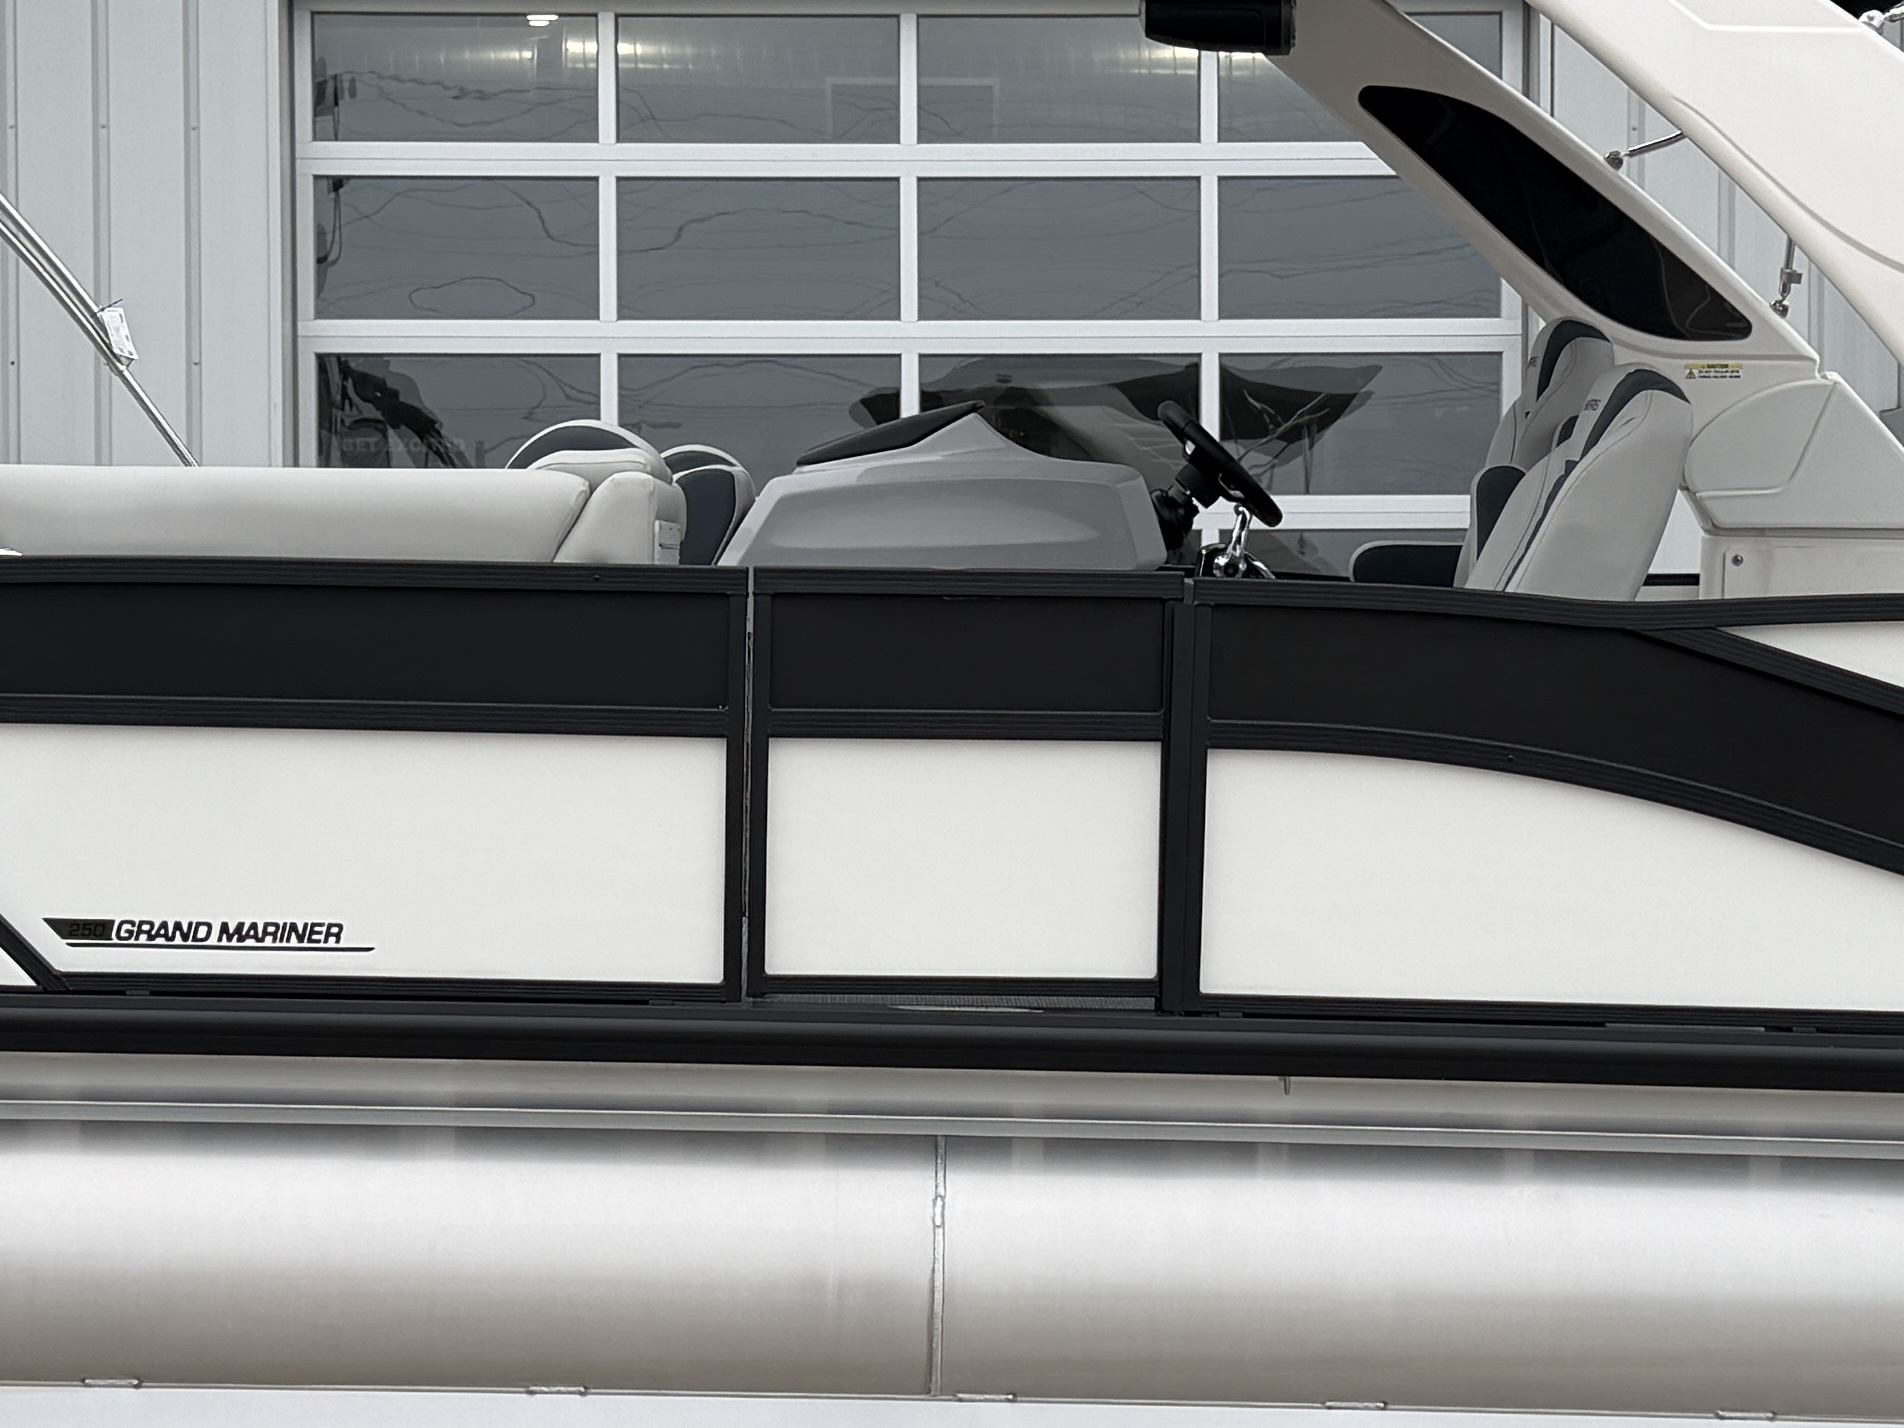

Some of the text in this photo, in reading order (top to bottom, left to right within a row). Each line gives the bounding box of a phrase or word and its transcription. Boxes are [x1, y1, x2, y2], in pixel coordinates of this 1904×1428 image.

[68, 919, 344, 944] 250 GRAND MARINER
